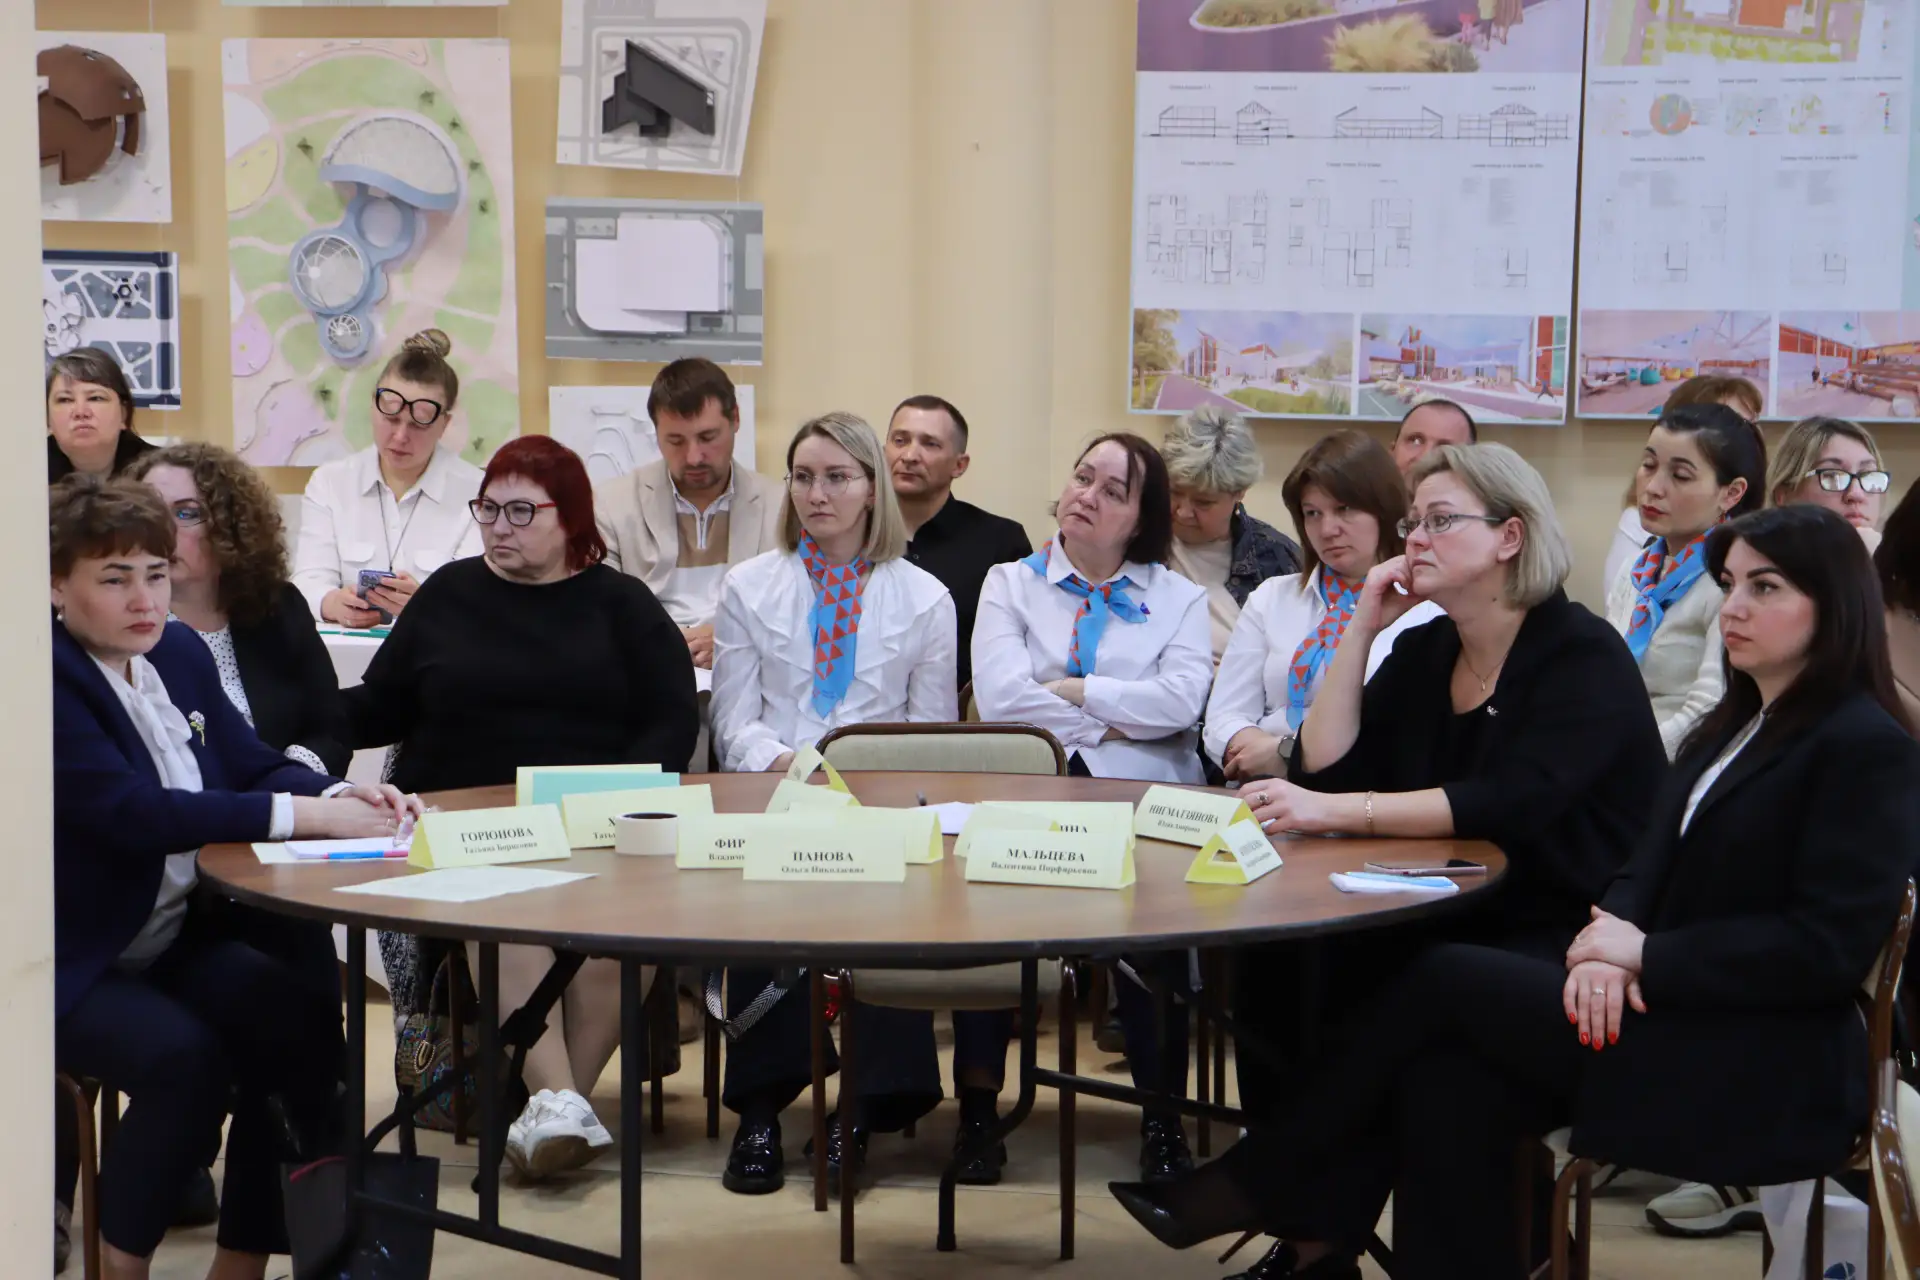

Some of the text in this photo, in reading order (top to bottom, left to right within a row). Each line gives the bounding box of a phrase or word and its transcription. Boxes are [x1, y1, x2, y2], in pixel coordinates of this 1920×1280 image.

[1060, 824, 1088, 833] ИНА
[461, 827, 534, 843] ГОРЮНОВА
[593, 831, 616, 840] Тать
[715, 838, 746, 848] ФИР
[793, 851, 854, 862] ПАНОВА
[1006, 848, 1086, 863] МАЛЬЦЕВА
[811, 866, 865, 874] Николаевна
[991, 861, 1037, 871] Валентина
